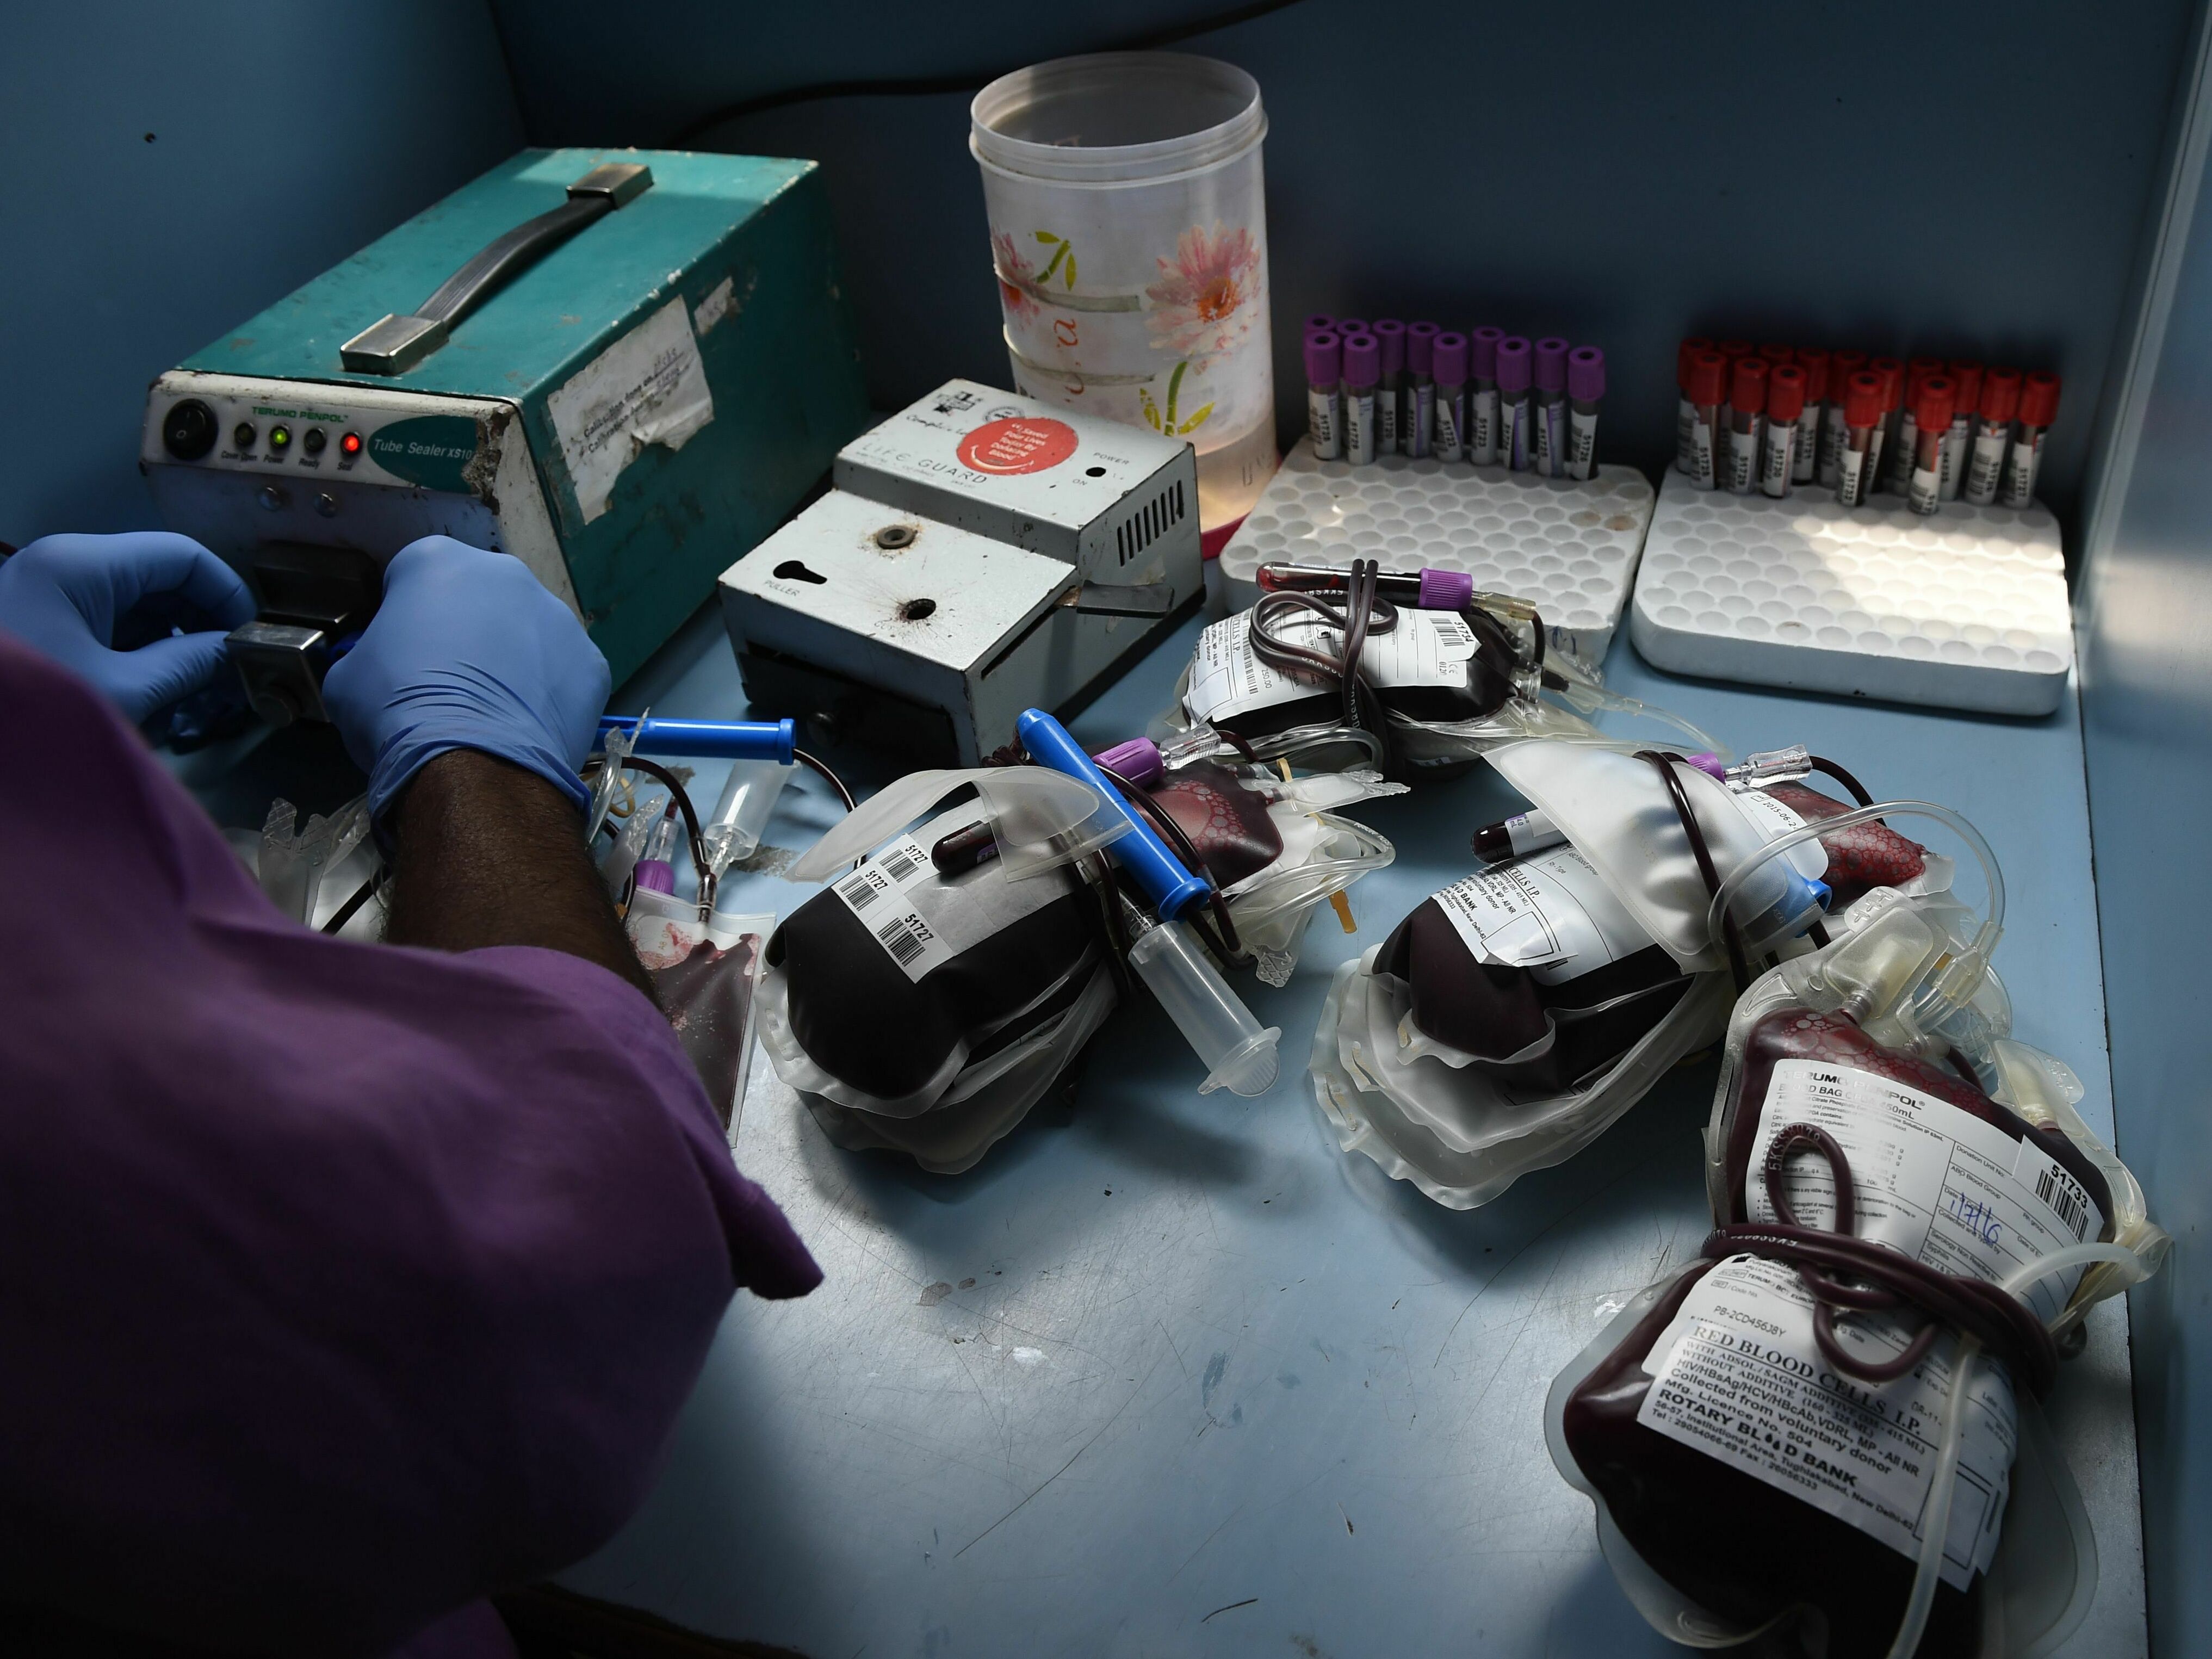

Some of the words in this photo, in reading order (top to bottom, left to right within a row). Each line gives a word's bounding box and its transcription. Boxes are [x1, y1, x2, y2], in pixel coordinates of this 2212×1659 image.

[252, 407, 296, 418] TERUMO
[374, 438, 404, 453] Tube
[407, 442, 448, 456] Sealer
[264, 455, 284, 463] Power
[299, 458, 319, 468] Ready
[337, 462, 353, 471] Seal
[1094, 452, 1130, 465] POWER
[918, 459, 988, 484] GUARD
[1073, 478, 1087, 486] ON
[763, 579, 801, 597] PULLER
[1454, 622, 1474, 642] 51734
[1232, 642, 1241, 654] I.P.
[1261, 668, 1272, 689] 250.00
[1439, 661, 1447, 676] 0120
[905, 845, 928, 863] 51727
[865, 870, 888, 890] 51727
[1508, 867, 1531, 887] CELLS
[1526, 886, 1540, 899] I.P.
[1460, 892, 1478, 912] BANK
[1485, 894, 1500, 910] donor
[1508, 905, 1517, 914] NR
[904, 913, 934, 942] 51727
[1819, 1086, 1843, 1097] BAG
[1879, 1101, 1914, 1120] 450mL
[1903, 1119, 1923, 1132] Solution
[1930, 1132, 1944, 1142] 63mL
[1956, 1145, 1982, 1163] Donation
[1983, 1160, 1995, 1173] Unit
[1950, 1165, 1965, 1177] ABO
[1965, 1172, 1983, 1187] Blood
[1984, 1181, 2002, 1199] Group
[2050, 1163, 2087, 1209] 51733
[1944, 1187, 1959, 1199] Date
[1938, 1208, 1962, 1227] Collected
[2030, 1219, 2045, 1234] group
[1921, 1254, 1934, 1266] HIV
[1925, 1240, 1950, 1262] Syphilis
[1931, 1229, 1957, 1252] Serology
[1957, 1247, 1970, 1261] Non
[1969, 1255, 1991, 1276] Reactive
[1731, 1285, 1747, 1294] Code
[1693, 1326, 1735, 1347] RED
[1738, 1339, 1814, 1378] BLOOD
[1819, 1372, 1887, 1415] CELLS
[1894, 1409, 1921, 1435] I.P.
[1682, 1349, 1735, 1373] WITHOUT
[1737, 1370, 1796, 1399] ADDITIVE
[1802, 1397, 1825, 1413] (160
[1852, 1420, 1874, 1438] ML)
[1686, 1340, 1716, 1355] WITH
[1801, 1385, 1855, 1414] ADDITIVE
[1887, 1428, 1904, 1441] 415
[1904, 1437, 1925, 1455] ML)
[1665, 1379, 1694, 1396] Mfg.
[1698, 1391, 1754, 1421] Licence
[1757, 1416, 1781, 1434] No.
[1787, 1431, 1813, 1448] 504
[1671, 1368, 1737, 1400] Collected
[1739, 1395, 1774, 1416] from
[1777, 1413, 1847, 1452] voluntary
[1849, 1447, 1893, 1475] donor
[1652, 1408, 1666, 1420] Tel
[1740, 1447, 1759, 1463] Fax
[1659, 1389, 1734, 1426] ROTARY
[1802, 1452, 1860, 1488] BANK
[1687, 1414, 1749, 1446] Institutional
[1750, 1443, 1777, 1462] Area,
[1781, 1456, 1849, 1498] Tughlakabad,
[1851, 1491, 1874, 1508] New
[1857, 1436, 1877, 1451] MP
[1884, 1451, 1901, 1467] All
[1901, 1460, 1920, 1477] NR
